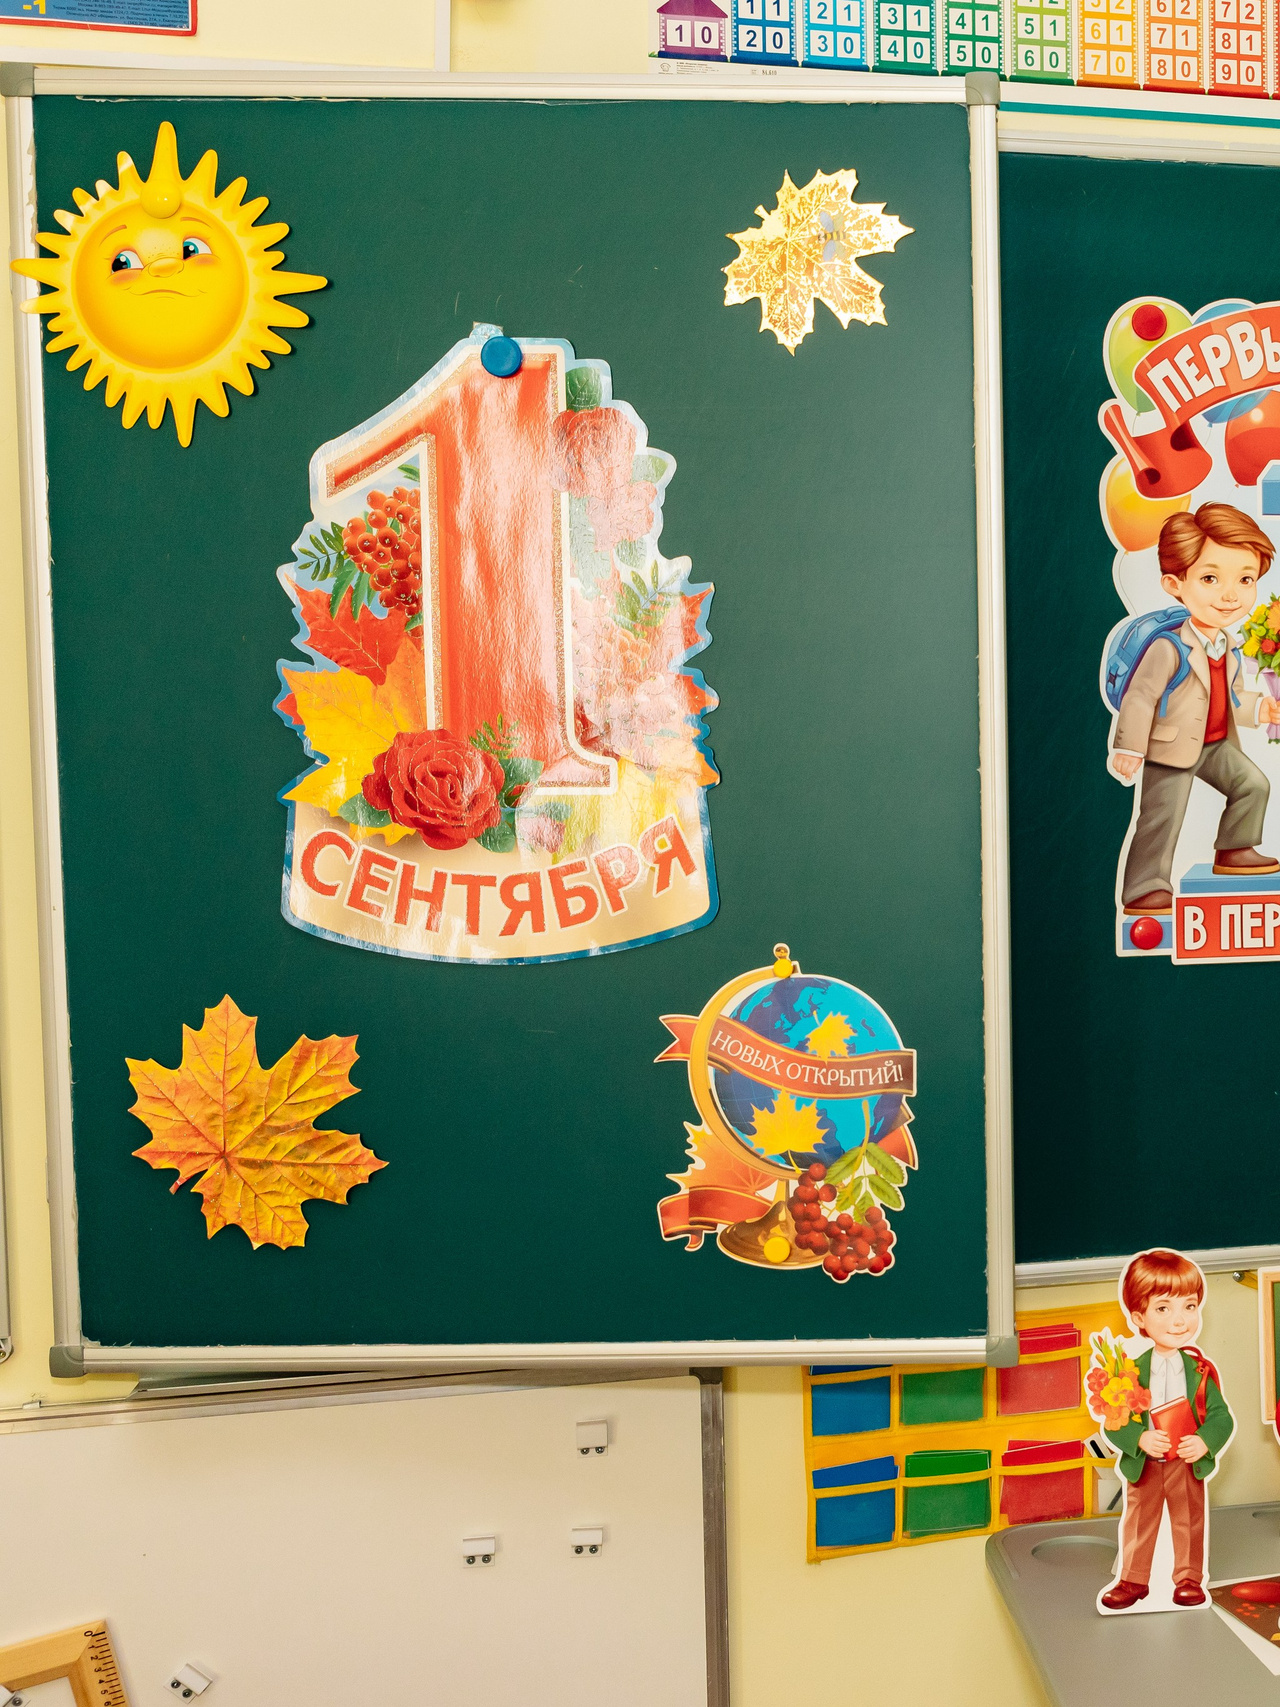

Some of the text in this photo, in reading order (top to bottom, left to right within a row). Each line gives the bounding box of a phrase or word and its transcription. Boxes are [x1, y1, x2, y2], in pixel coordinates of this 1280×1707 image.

[300, 814, 699, 938] СЕНТЯБРЯ
[1183, 905, 1207, 951] В
[711, 1030, 904, 1087] НОВЫХ ОТКРЫТИЙ!
